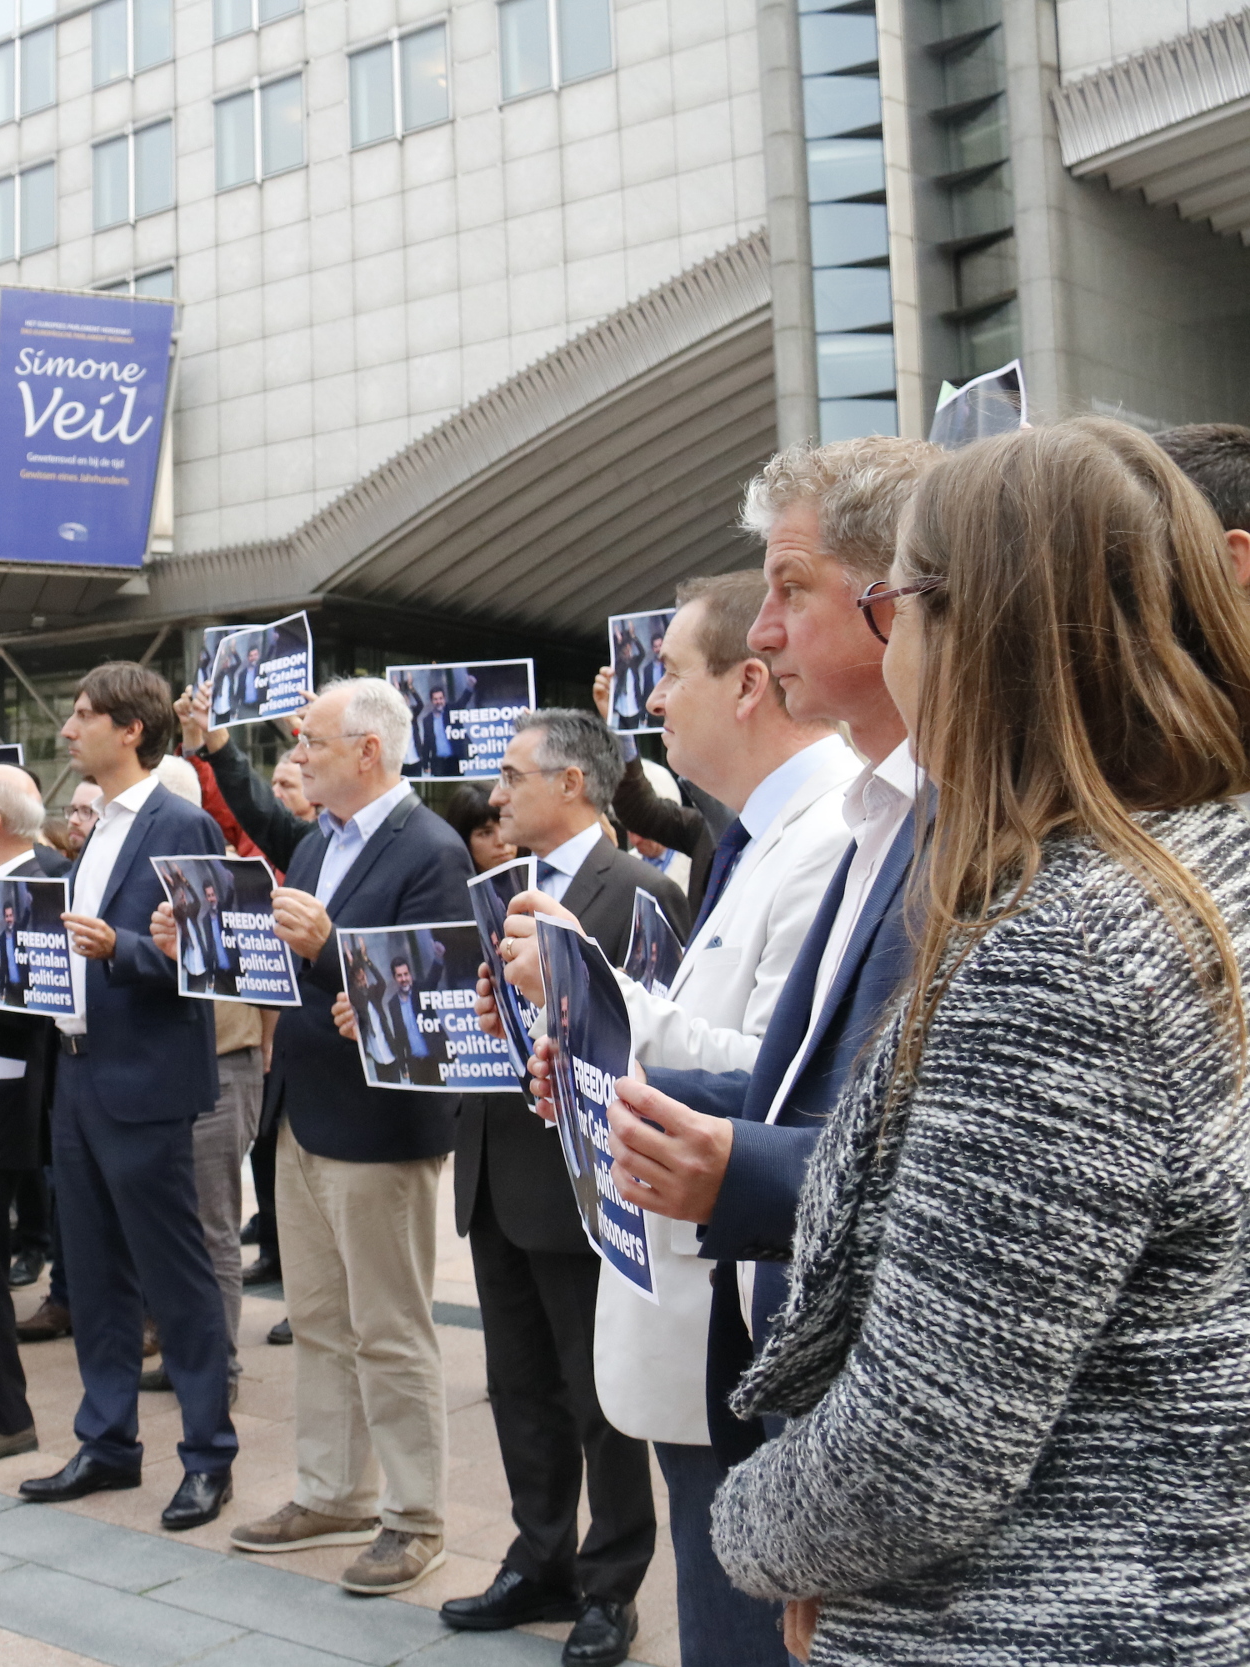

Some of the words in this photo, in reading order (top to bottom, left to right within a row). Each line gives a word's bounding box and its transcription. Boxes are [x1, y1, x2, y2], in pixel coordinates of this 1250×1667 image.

[14, 347, 147, 383] Simone
[17, 380, 153, 445] Veil
[259, 652, 306, 675] FREEDOM
[254, 676, 268, 688] for
[269, 667, 306, 684] Catalan
[266, 678, 306, 700] political
[259, 695, 306, 715] prisoners
[445, 725, 467, 739] for
[468, 738, 508, 757] politi
[221, 911, 276, 930] FREEDOM
[17, 931, 66, 949] FREEDOM
[221, 930, 236, 948] for
[237, 933, 281, 951] Catalan
[14, 948, 29, 964] for
[29, 950, 67, 968] Catalan
[239, 953, 286, 973] political
[29, 969, 69, 987] political
[235, 973, 290, 992] prisoners
[23, 987, 71, 1006] prisoners
[419, 989, 478, 1010] FREED
[416, 1013, 441, 1033] for
[444, 1013, 481, 1032] Cata
[445, 1035, 508, 1059] politica
[597, 1200, 645, 1266] prisoners
